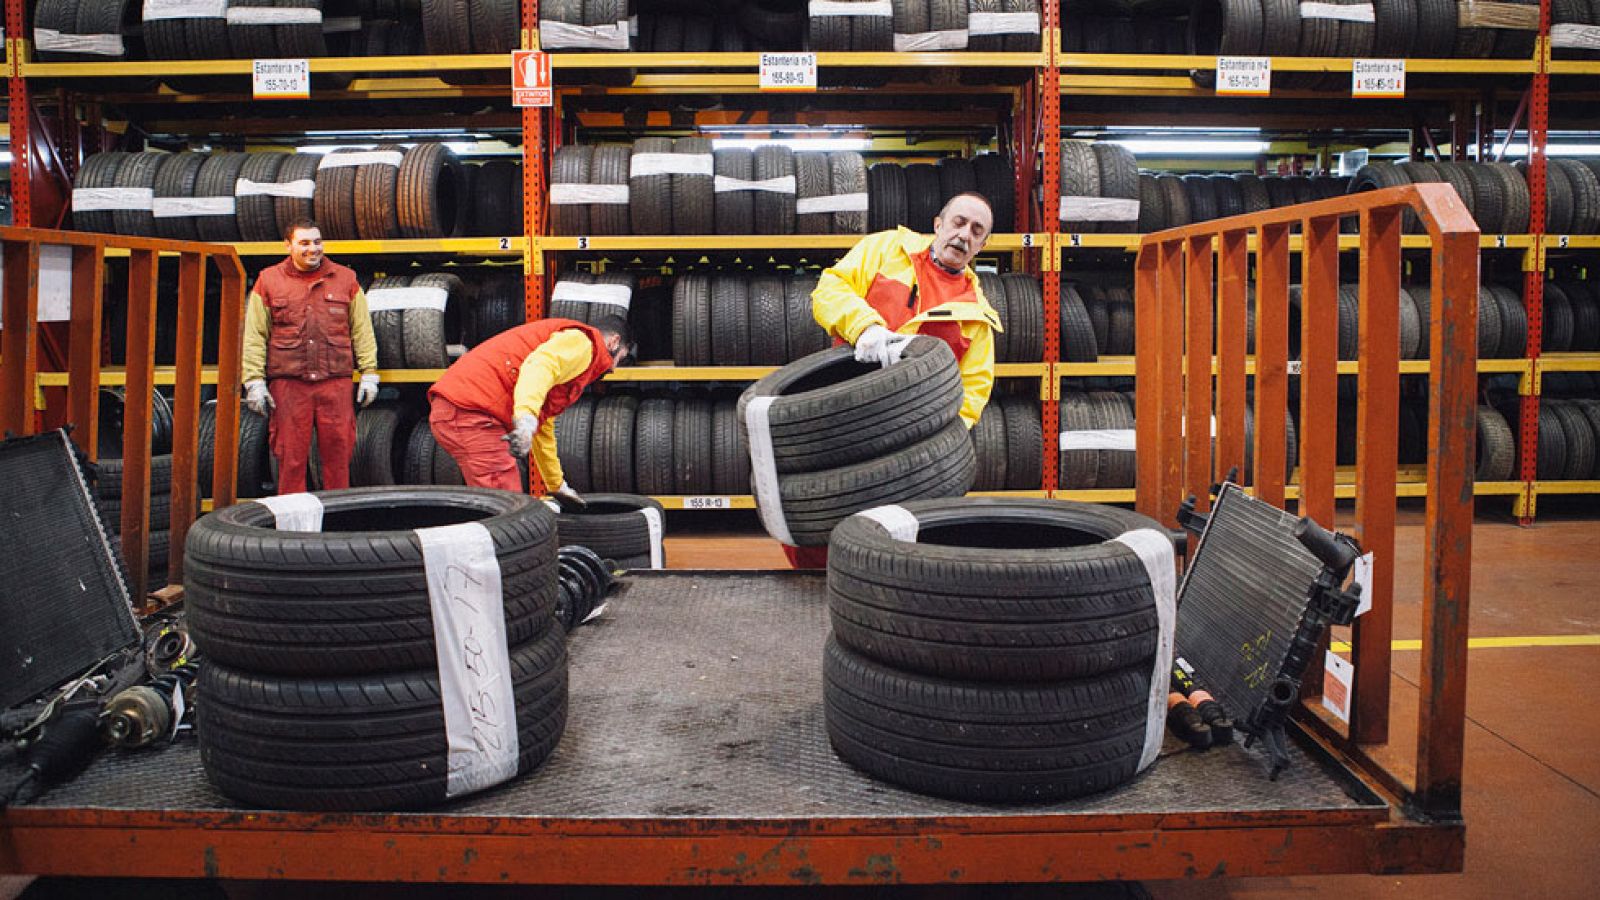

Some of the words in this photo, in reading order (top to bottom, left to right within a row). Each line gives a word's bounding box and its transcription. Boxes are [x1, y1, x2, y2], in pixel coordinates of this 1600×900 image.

[500, 237, 509, 249] 2
[579, 237, 587, 249] 3
[1023, 234, 1031, 246] 3
[1070, 234, 1080, 246] 4
